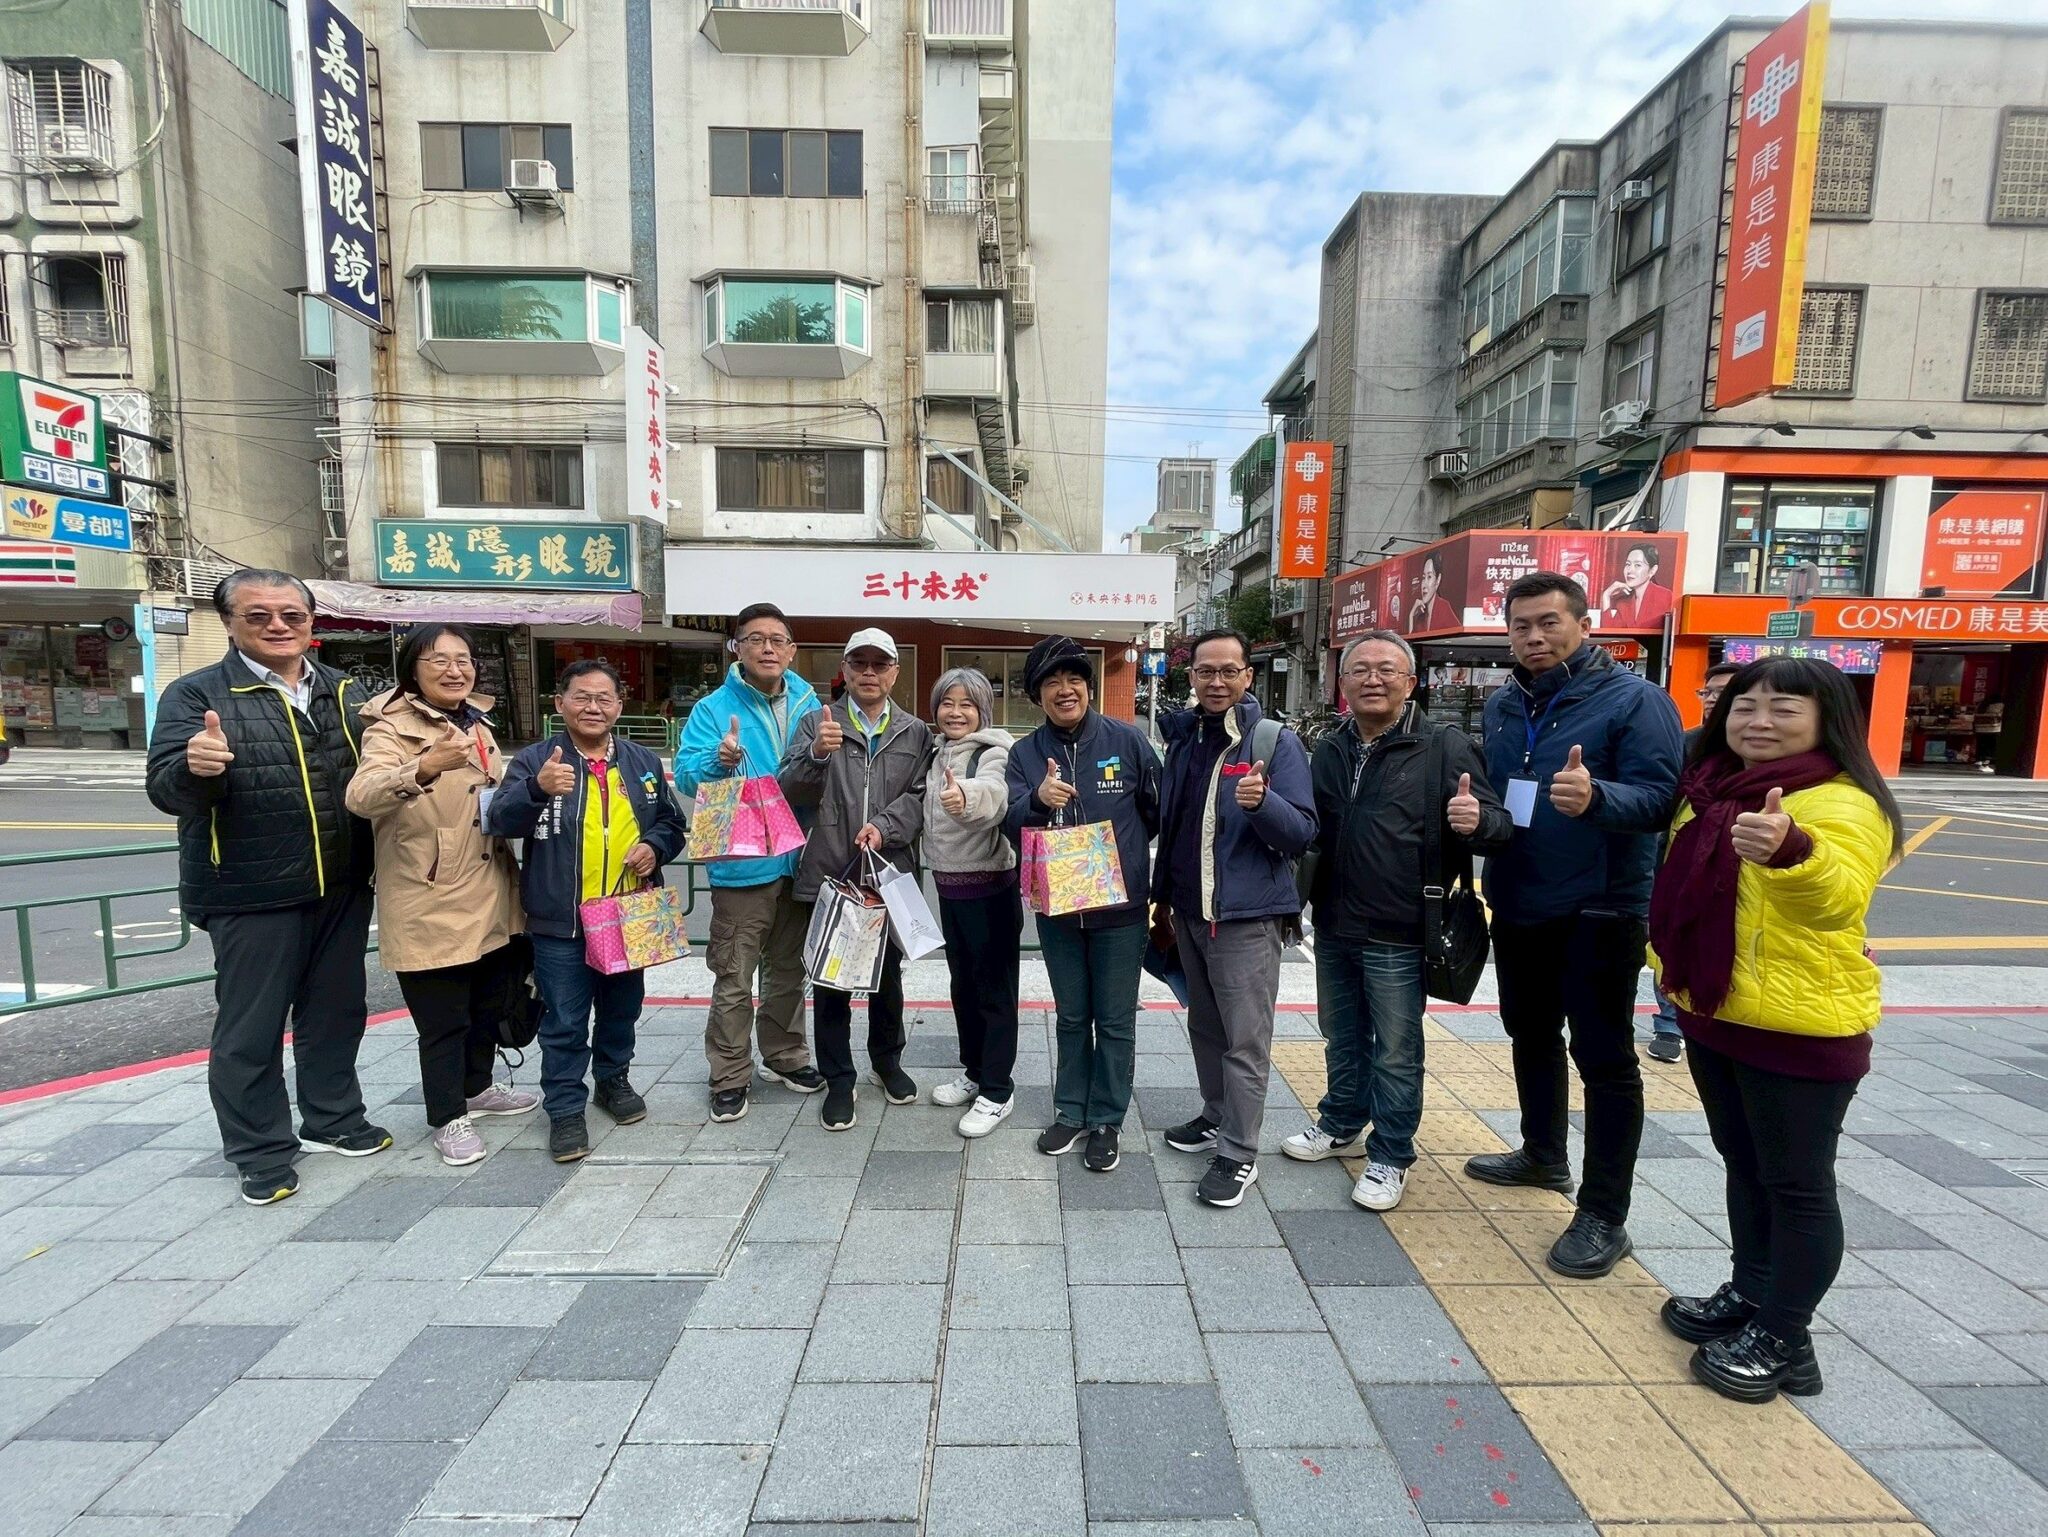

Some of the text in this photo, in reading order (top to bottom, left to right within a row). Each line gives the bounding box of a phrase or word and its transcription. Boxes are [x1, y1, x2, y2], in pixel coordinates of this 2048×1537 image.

[315, 17, 376, 306] 嘉誠眼鏡
[1741, 136, 1783, 282] 康是美
[646, 348, 662, 484] 三十未央
[28, 459, 49, 470] ATM
[12, 519, 48, 530] mentor
[1295, 493, 1319, 565] 康是美
[1938, 518, 2025, 535] 康是美網購
[385, 526, 620, 581] 嘉誠隱形眼鏡
[862, 570, 980, 601] 三十未央
[1838, 606, 1962, 630] COSMED
[1097, 780, 1123, 789] TAIPEI
